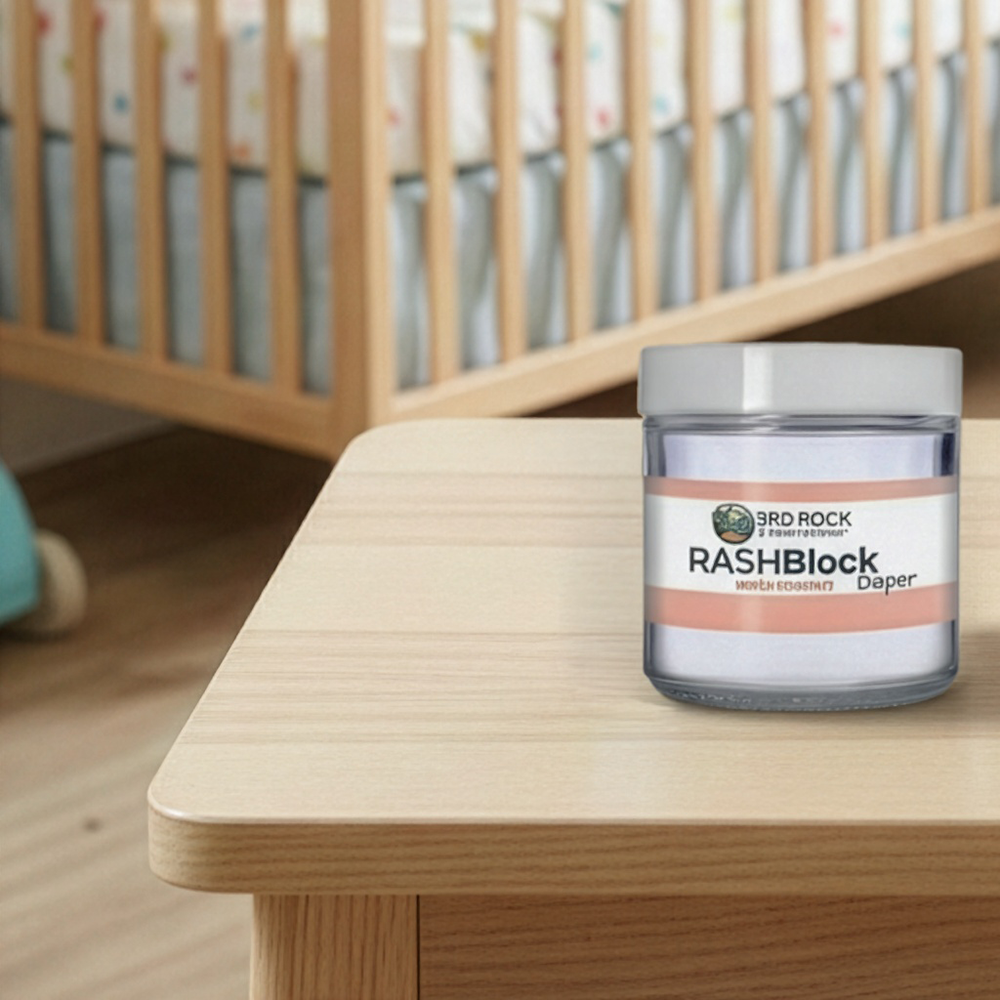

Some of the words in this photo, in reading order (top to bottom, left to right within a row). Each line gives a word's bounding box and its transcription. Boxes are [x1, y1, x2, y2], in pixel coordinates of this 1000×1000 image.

[757, 511, 794, 526] 3RD
[798, 511, 852, 527] ROCK
[689, 546, 879, 575] RASHBlock
[857, 573, 917, 596] Daper
